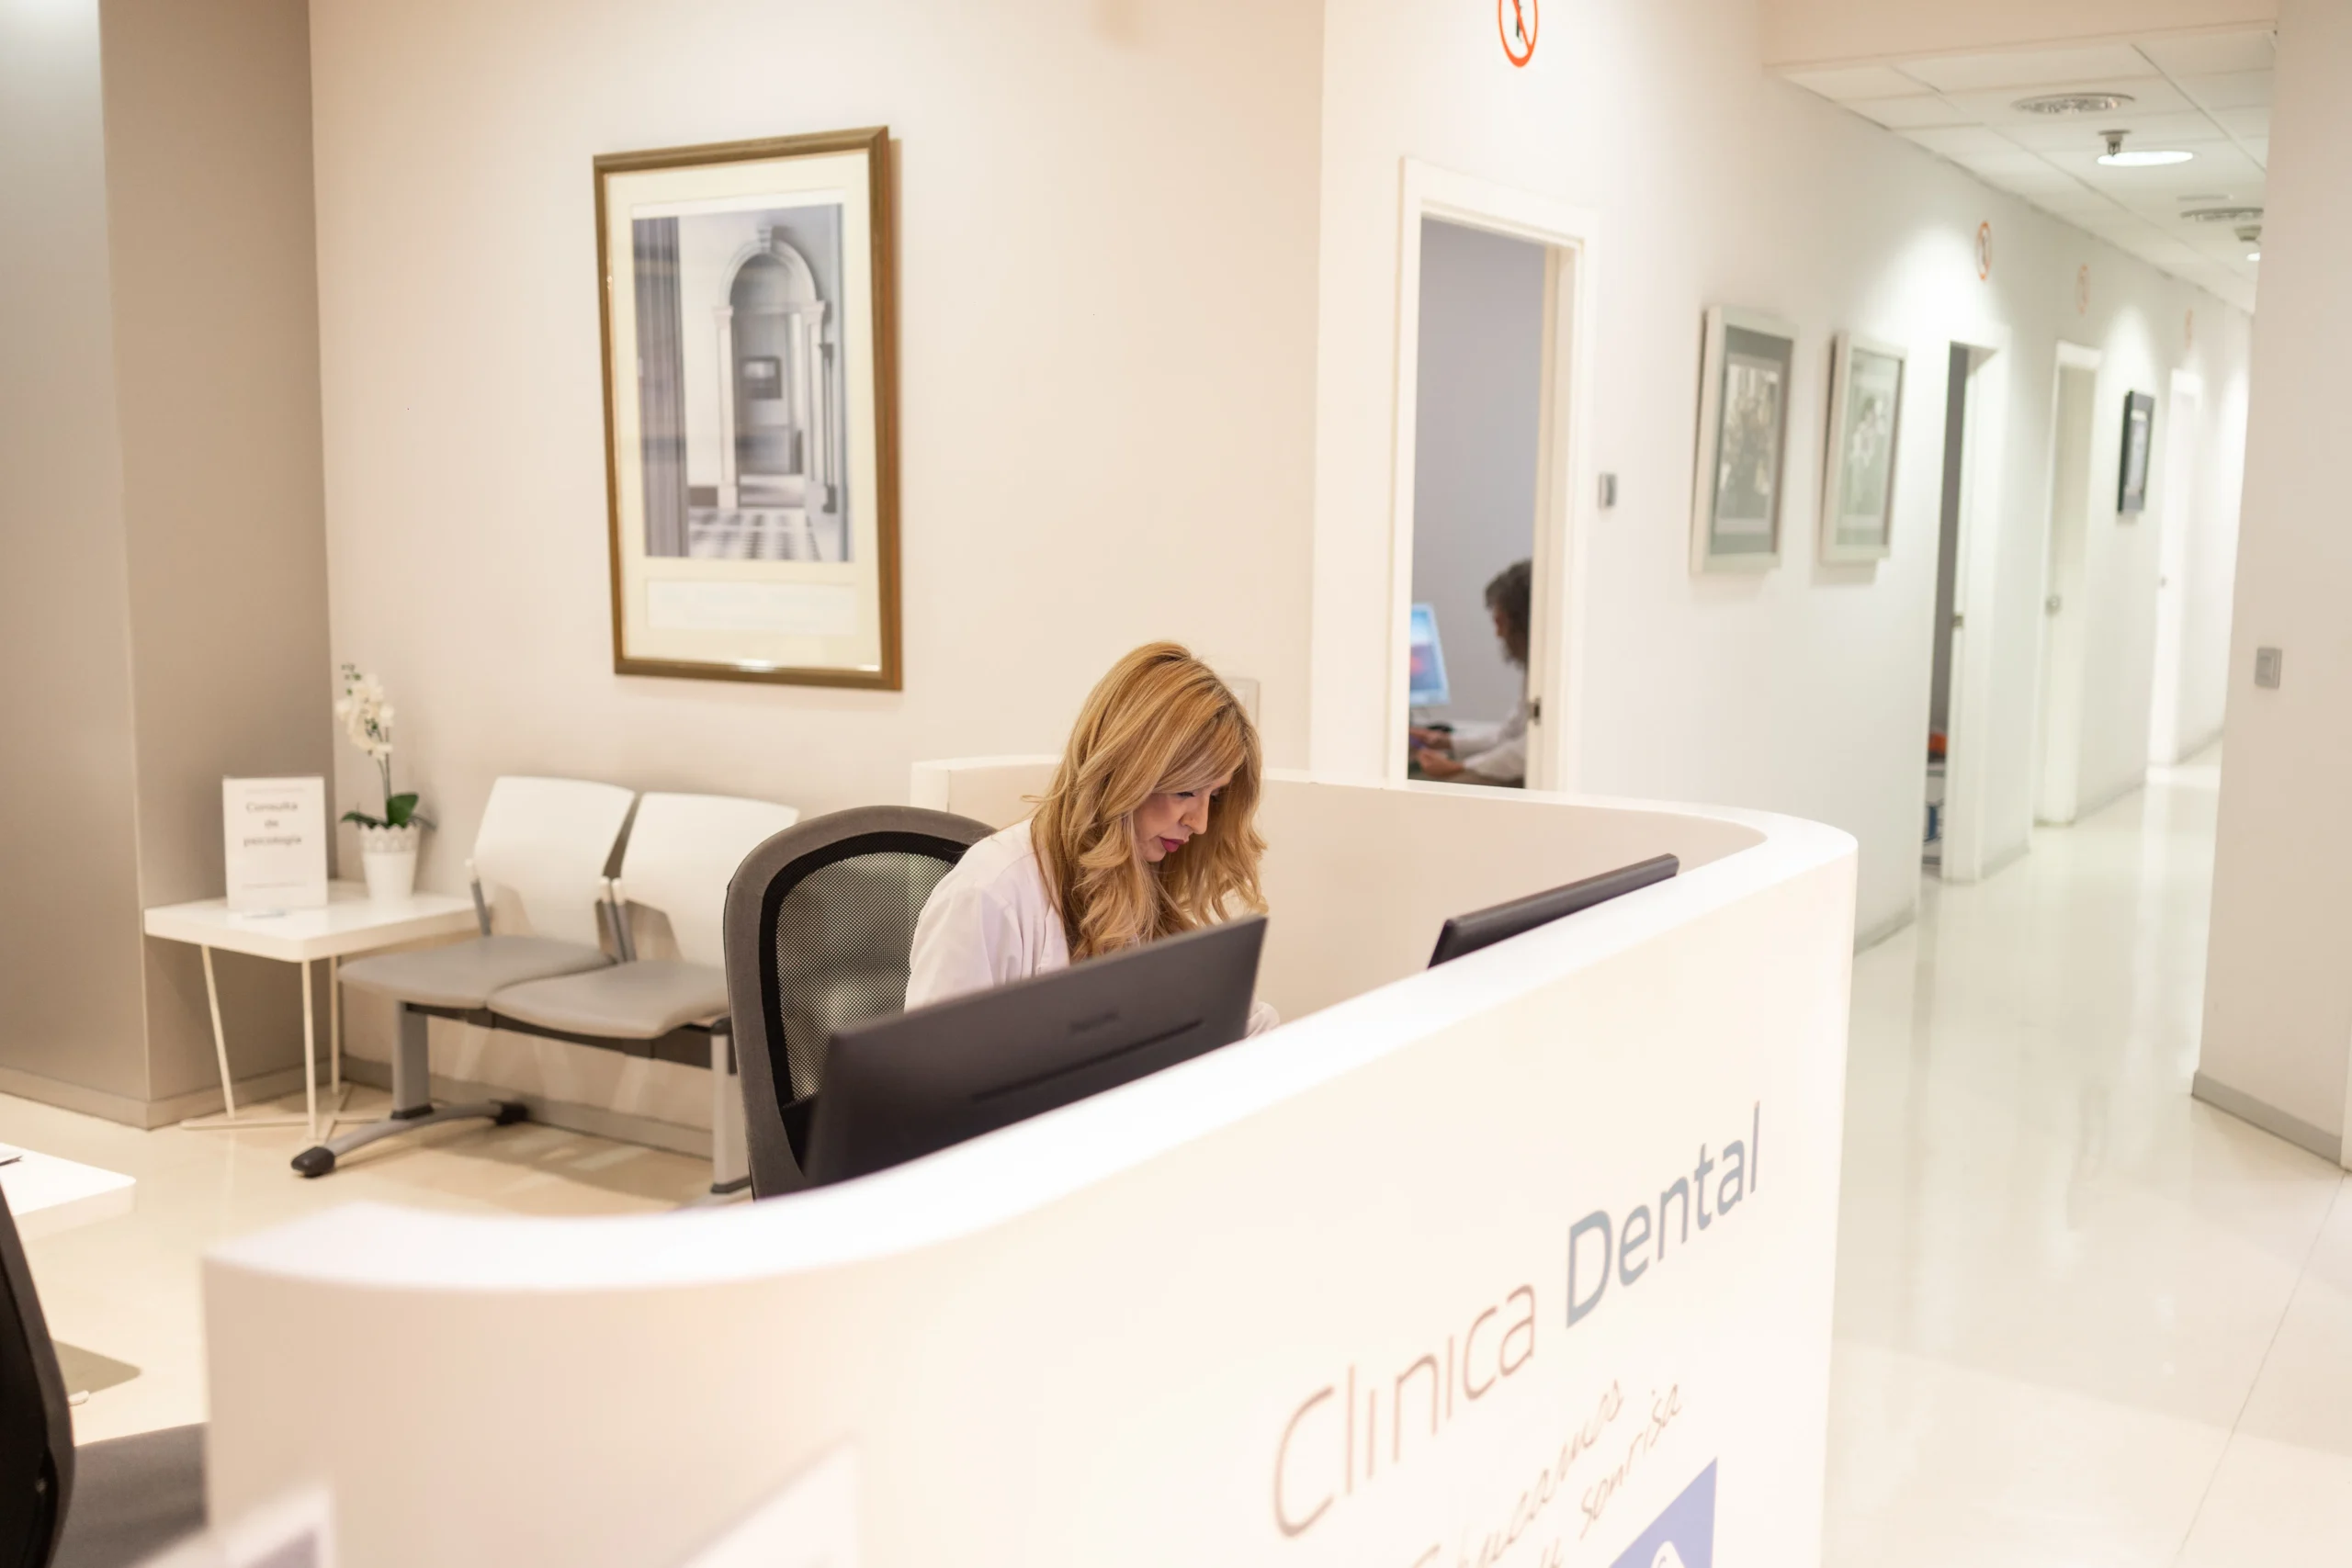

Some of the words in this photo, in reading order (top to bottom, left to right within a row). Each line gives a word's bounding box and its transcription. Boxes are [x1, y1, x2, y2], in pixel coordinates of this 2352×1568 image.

[245, 800, 299, 814] Consulta
[264, 818, 279, 829] de
[1272, 1283, 1536, 1540] Clinica
[1565, 1100, 1760, 1330] Dental
[1578, 1382, 1682, 1542] sonrisa
